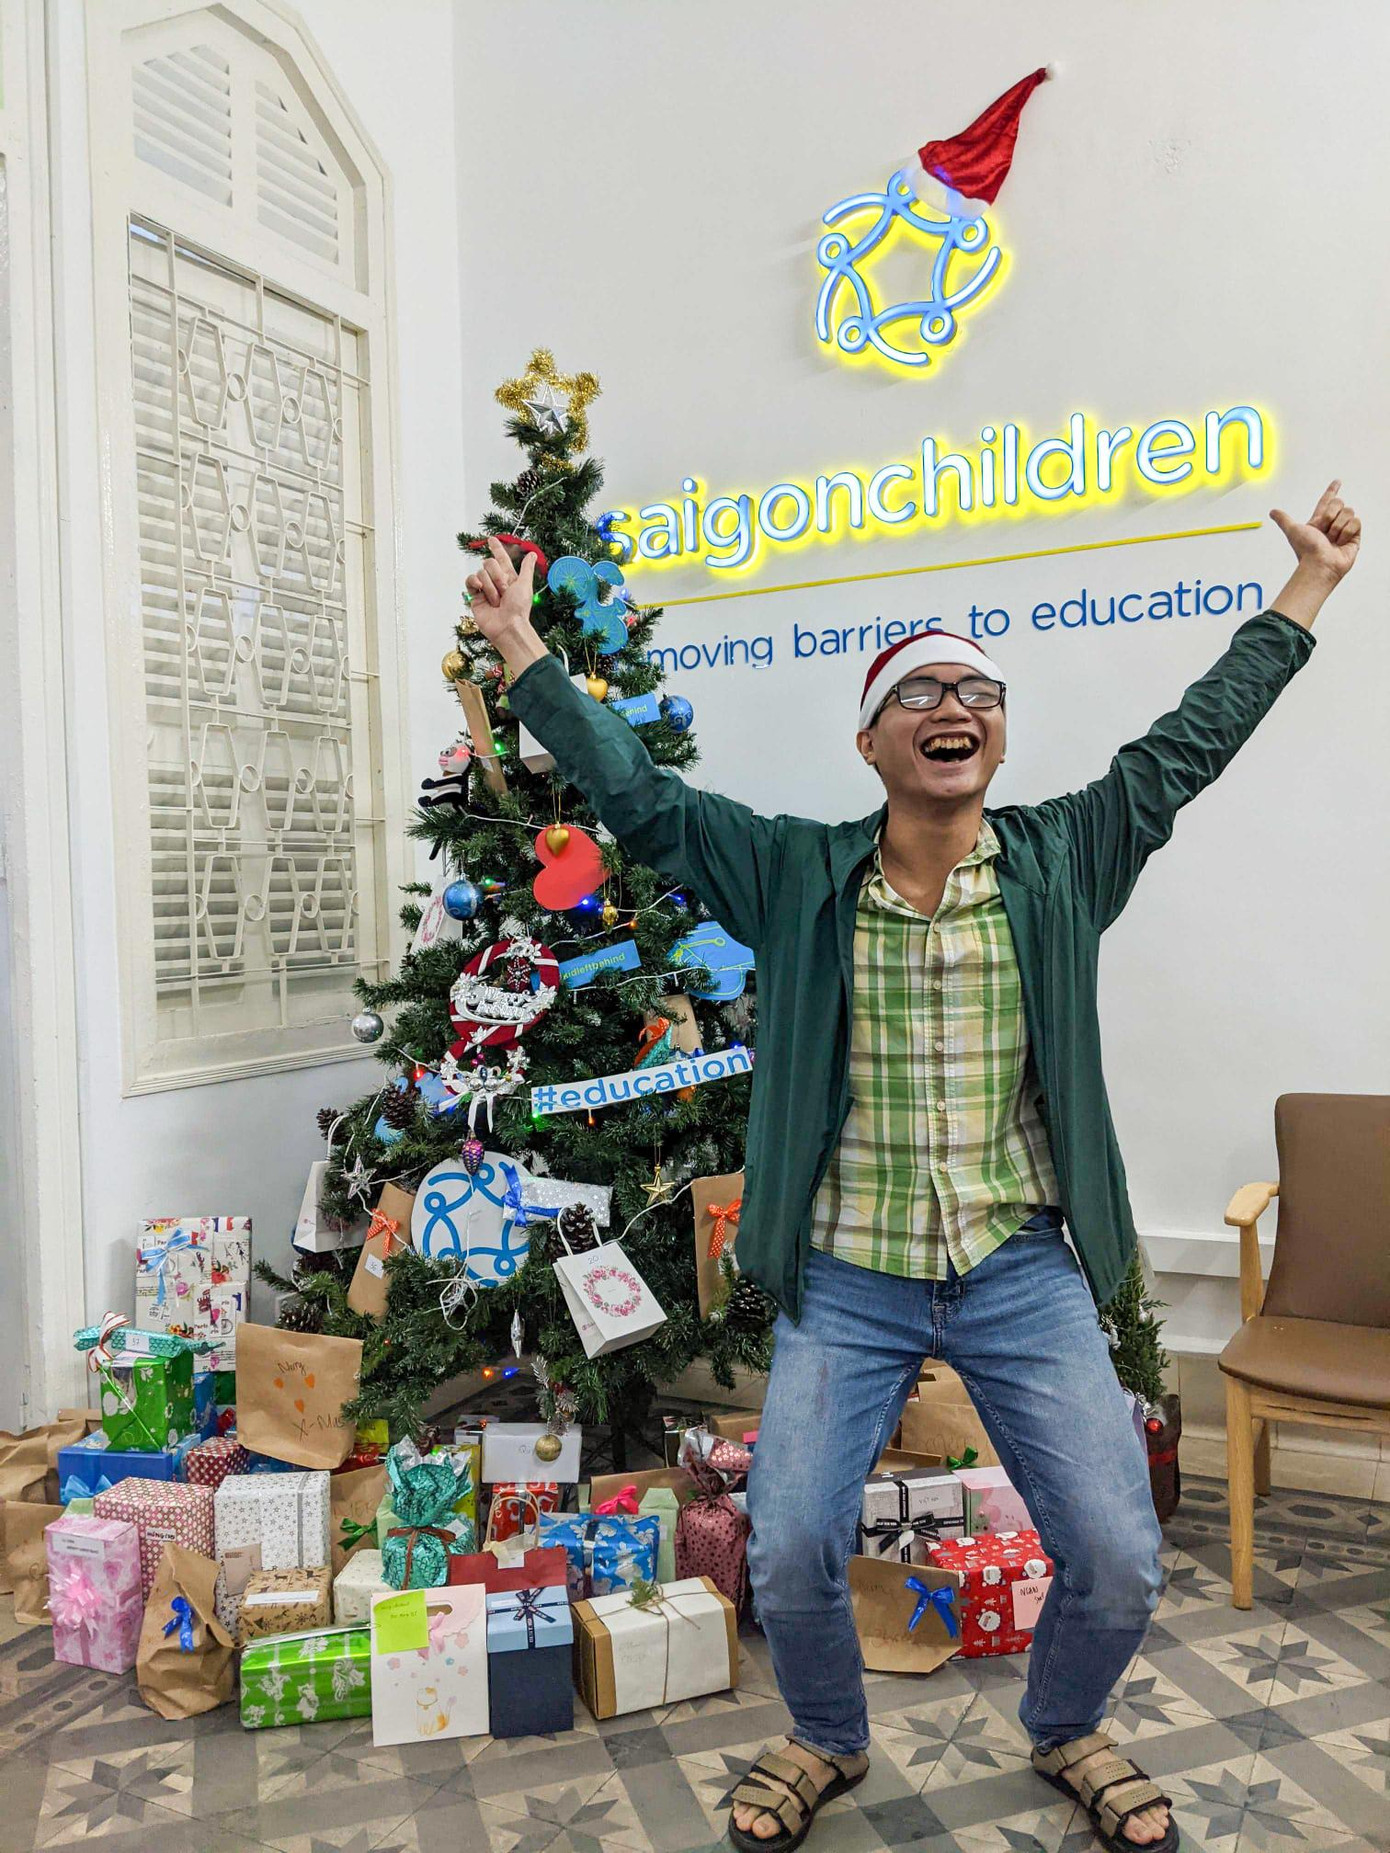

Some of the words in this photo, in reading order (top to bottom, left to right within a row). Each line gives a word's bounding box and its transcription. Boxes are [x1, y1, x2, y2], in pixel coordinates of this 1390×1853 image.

[597, 405, 1264, 568] saigonchildren
[647, 634, 774, 669] moving
[968, 605, 1010, 639] to
[1031, 579, 1263, 631] education
[534, 1053, 750, 1113] #education
